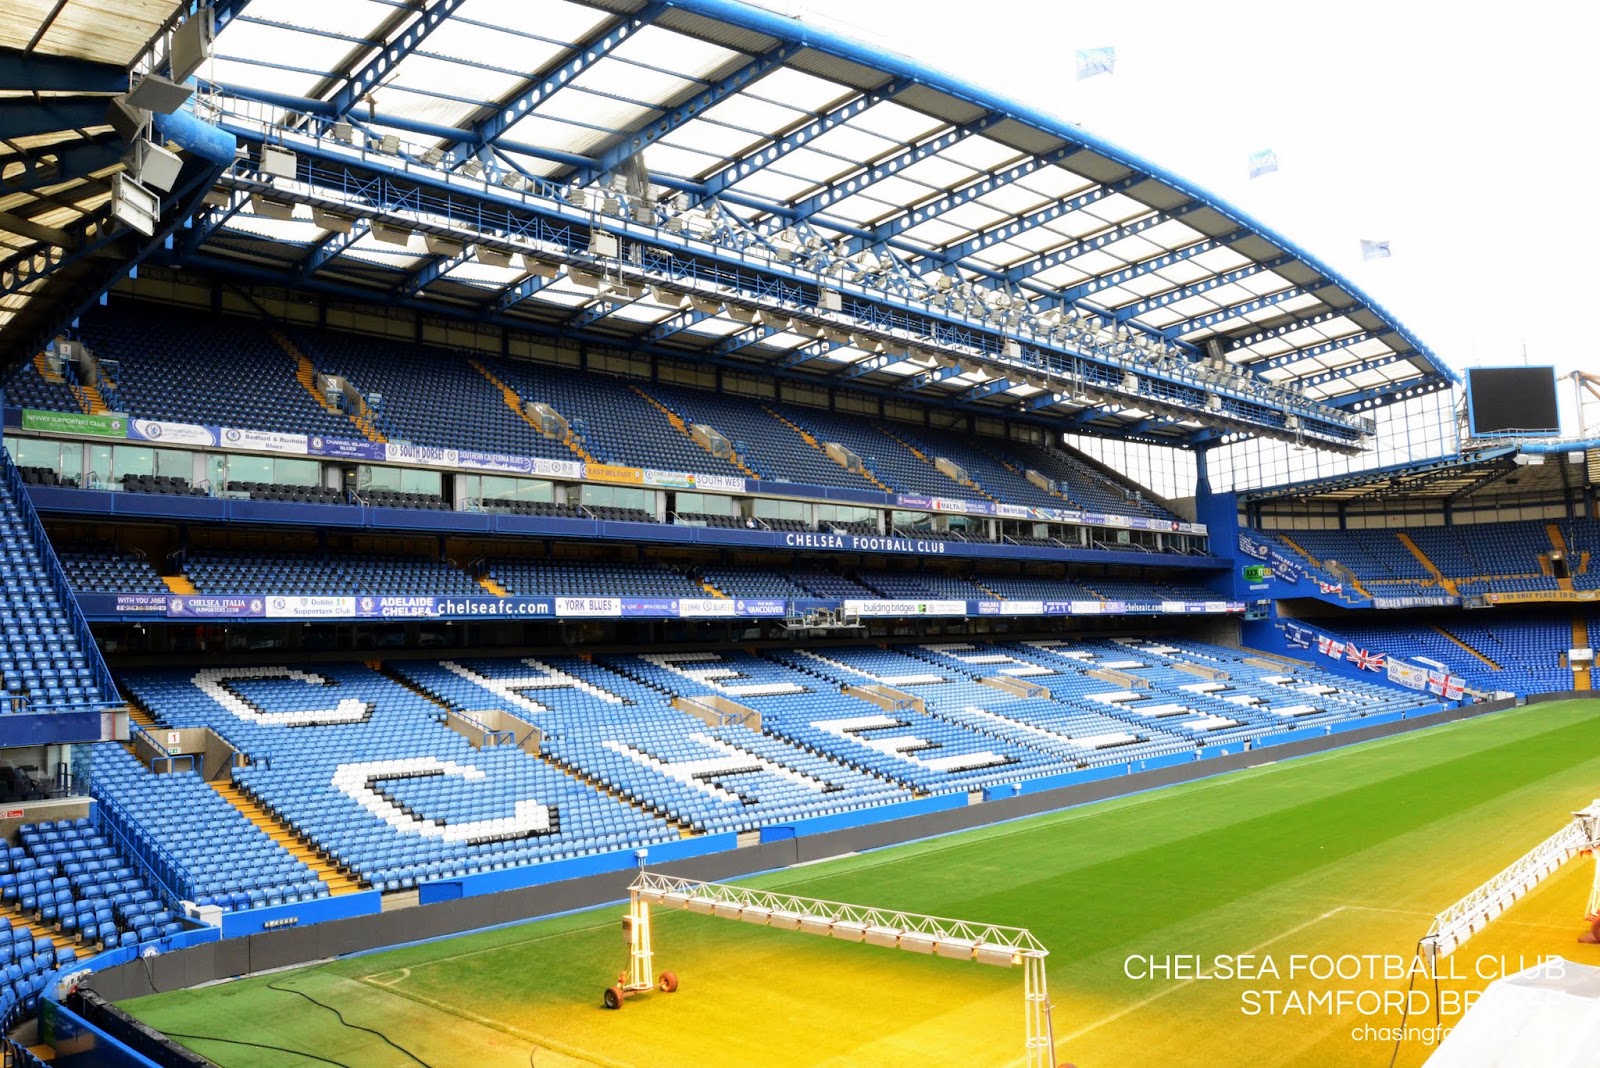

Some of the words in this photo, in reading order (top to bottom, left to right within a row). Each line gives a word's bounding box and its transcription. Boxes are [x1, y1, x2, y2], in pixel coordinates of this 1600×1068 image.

[27, 414, 51, 422] NEWRY
[51, 416, 89, 426] SUPPORTERS
[89, 420, 106, 428] CLUB
[279, 437, 307, 445] Rushden
[400, 444, 420, 458] SOUTH
[421, 446, 445, 461] DORSET
[460, 450, 484, 460] SOUTHERN
[484, 453, 509, 463] CALIFORNIA
[509, 455, 524, 464] BLUES
[588, 467, 605, 475] EAST
[605, 469, 631, 478] BELFAST
[697, 474, 723, 485] SOUTH
[724, 477, 745, 488] WEST
[941, 502, 960, 511] MALTA
[786, 533, 844, 548] CHELSEA
[853, 537, 914, 551] FOOTBALL
[917, 541, 945, 553] CLUB
[188, 599, 219, 607] CHELSEA
[222, 599, 246, 607] ITALIA
[311, 598, 334, 606] Dublin
[380, 597, 434, 607] ADELAIDE
[437, 600, 549, 615] chelseafc.com
[565, 599, 585, 611] YORK
[589, 599, 613, 611] BLUES
[293, 607, 333, 615] Supporters
[335, 607, 351, 615] Club
[382, 607, 432, 616] CHELSEA
[747, 606, 784, 614] VANCOUVER
[863, 602, 891, 614] building
[891, 602, 915, 614] bridges
[1388, 674, 1413, 687] CHELSEA
